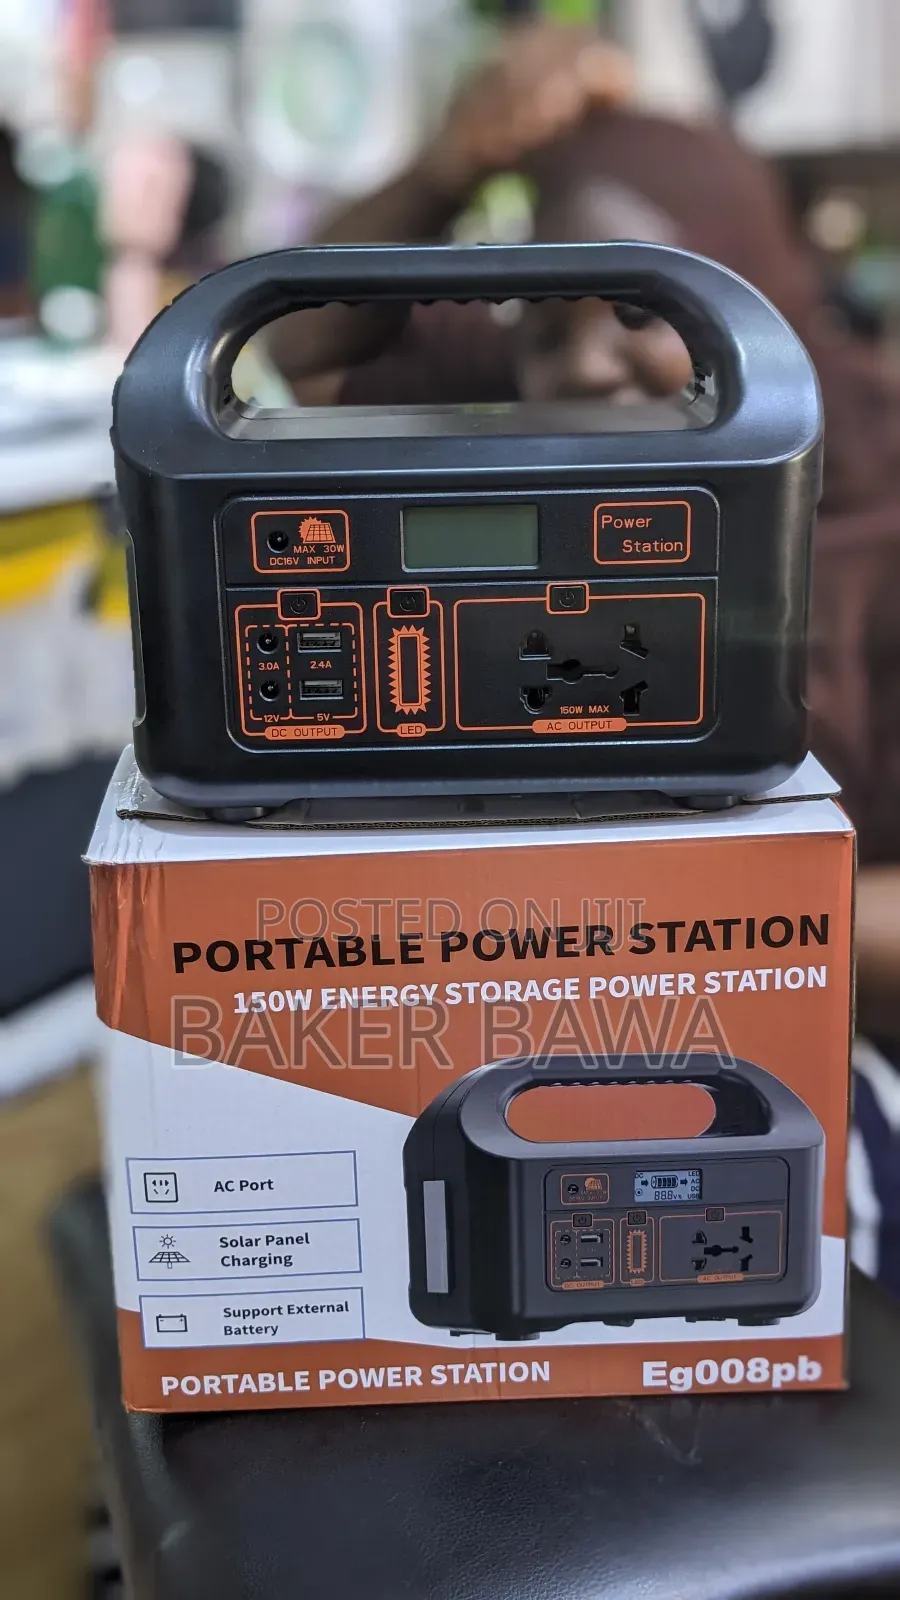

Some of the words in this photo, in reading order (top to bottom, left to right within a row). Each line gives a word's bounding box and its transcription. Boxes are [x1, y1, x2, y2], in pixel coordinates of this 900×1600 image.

[601, 514, 652, 529] Power
[293, 545, 316, 554] MAX
[323, 544, 345, 553] 30W
[622, 538, 683, 553] Station
[269, 557, 300, 566] DC16V
[307, 556, 335, 565] INPUT
[258, 662, 280, 671] 3.0A
[310, 661, 332, 669] 2.4A
[559, 705, 583, 715] 150W
[588, 704, 610, 714] MAX
[263, 714, 280, 723] 12V
[316, 713, 331, 722] 5V
[271, 728, 287, 737] DC
[293, 727, 338, 737] OUTPUT
[400, 725, 423, 735] LED
[546, 721, 562, 731] AC
[568, 720, 612, 730] OUTPUT
[173, 932, 425, 974] PORTABLE
[440, 924, 616, 963] POWER
[629, 913, 829, 955] STATION
[233, 988, 312, 1014] 150W
[320, 983, 439, 1011] ENERGY
[444, 977, 580, 1006] STORAGE
[589, 972, 696, 999] POWER
[703, 965, 827, 995] STATION
[213, 1180, 235, 1193] AC
[239, 1178, 274, 1192] Port
[219, 1235, 261, 1249] Solar
[265, 1232, 310, 1246] Panel
[220, 1252, 293, 1269] Charging
[223, 1304, 283, 1320] Support
[287, 1301, 349, 1316] External
[223, 1322, 279, 1337] Battery
[160, 1369, 311, 1397] PORTABLE
[318, 1364, 423, 1391] POWER
[429, 1359, 551, 1387] STATION
[641, 1355, 823, 1393] Eg008pb
